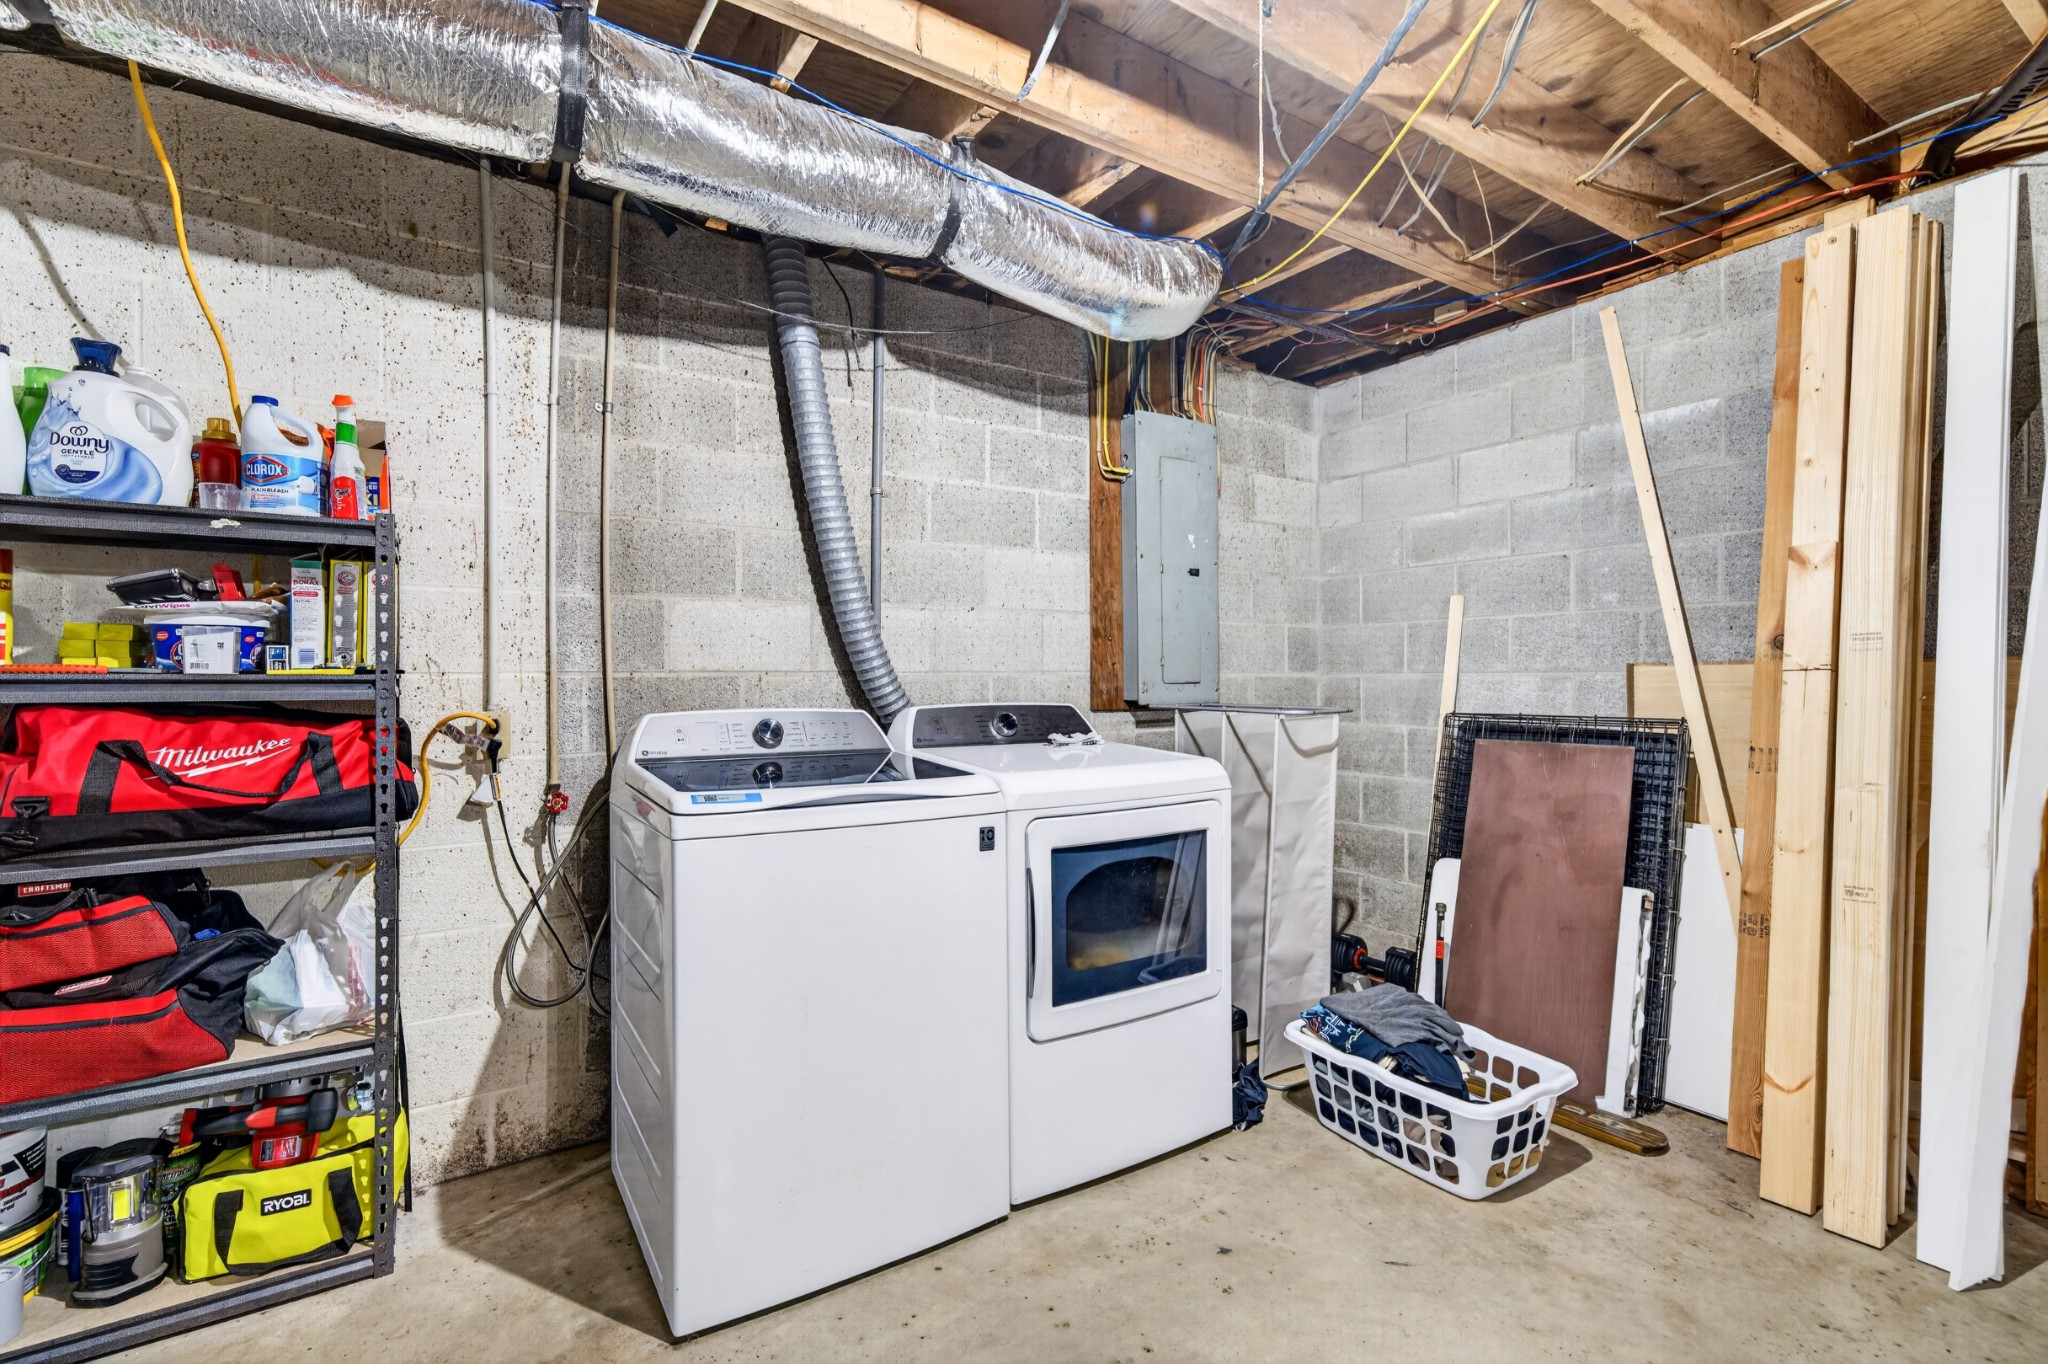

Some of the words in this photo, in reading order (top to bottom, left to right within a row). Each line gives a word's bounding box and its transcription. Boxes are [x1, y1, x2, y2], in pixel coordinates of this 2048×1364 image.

[50, 432, 110, 453] Downy
[246, 463, 283, 476] CLOROX
[147, 737, 291, 768] Milwaukee
[263, 1193, 310, 1213] RYOBI
